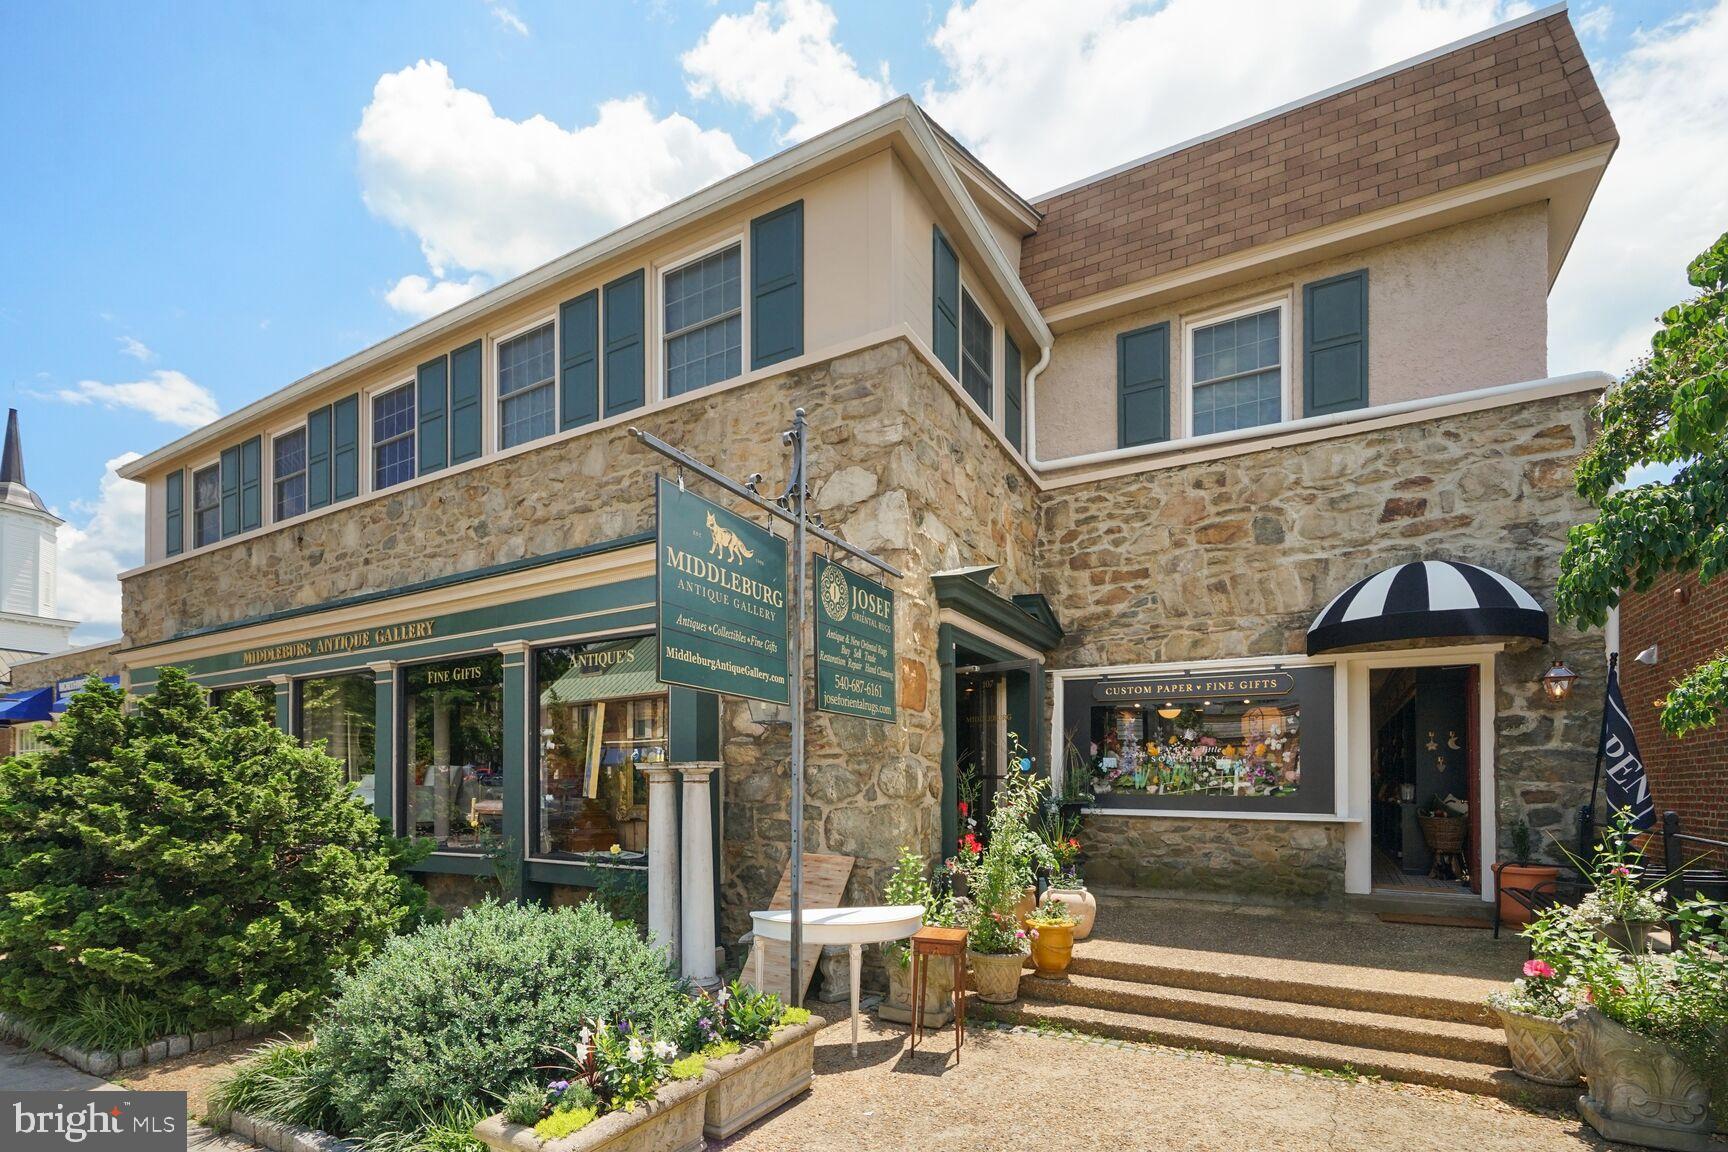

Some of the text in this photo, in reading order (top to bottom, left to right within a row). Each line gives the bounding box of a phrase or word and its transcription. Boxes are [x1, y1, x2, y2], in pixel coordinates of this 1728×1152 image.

[666, 546, 784, 608] MIDDLEBURG
[678, 579, 776, 622] ANTIQUE GALLERY
[852, 586, 891, 619] JOSEF
[676, 613, 778, 654] Antiques Collectibles Fine Gifts
[851, 611, 891, 634] ORIENTAL RUGS
[243, 620, 435, 665] MIDDLEBURG ANTIQUE GALLERY
[826, 628, 845, 643] Antique
[850, 636, 860, 647] New
[860, 639, 878, 654] Oriental
[877, 645, 888, 658] Rugs
[841, 645, 877, 663] Buy Sell Trade
[568, 649, 636, 669] ANTIQUE'S
[666, 646, 785, 685] MiddleburgAntiqueGallery.com
[820, 650, 846, 666] Restoration
[847, 658, 863, 671] Repair
[864, 663, 877, 675] Hand
[427, 666, 482, 685] FINE GIFTS
[834, 674, 883, 698] 540-687-6161
[1105, 679, 1278, 696] CUSTOM PAPER FINE GIFTS
[823, 691, 892, 716] joseforientalrugs.com
[1605, 724, 1653, 806] PEN
